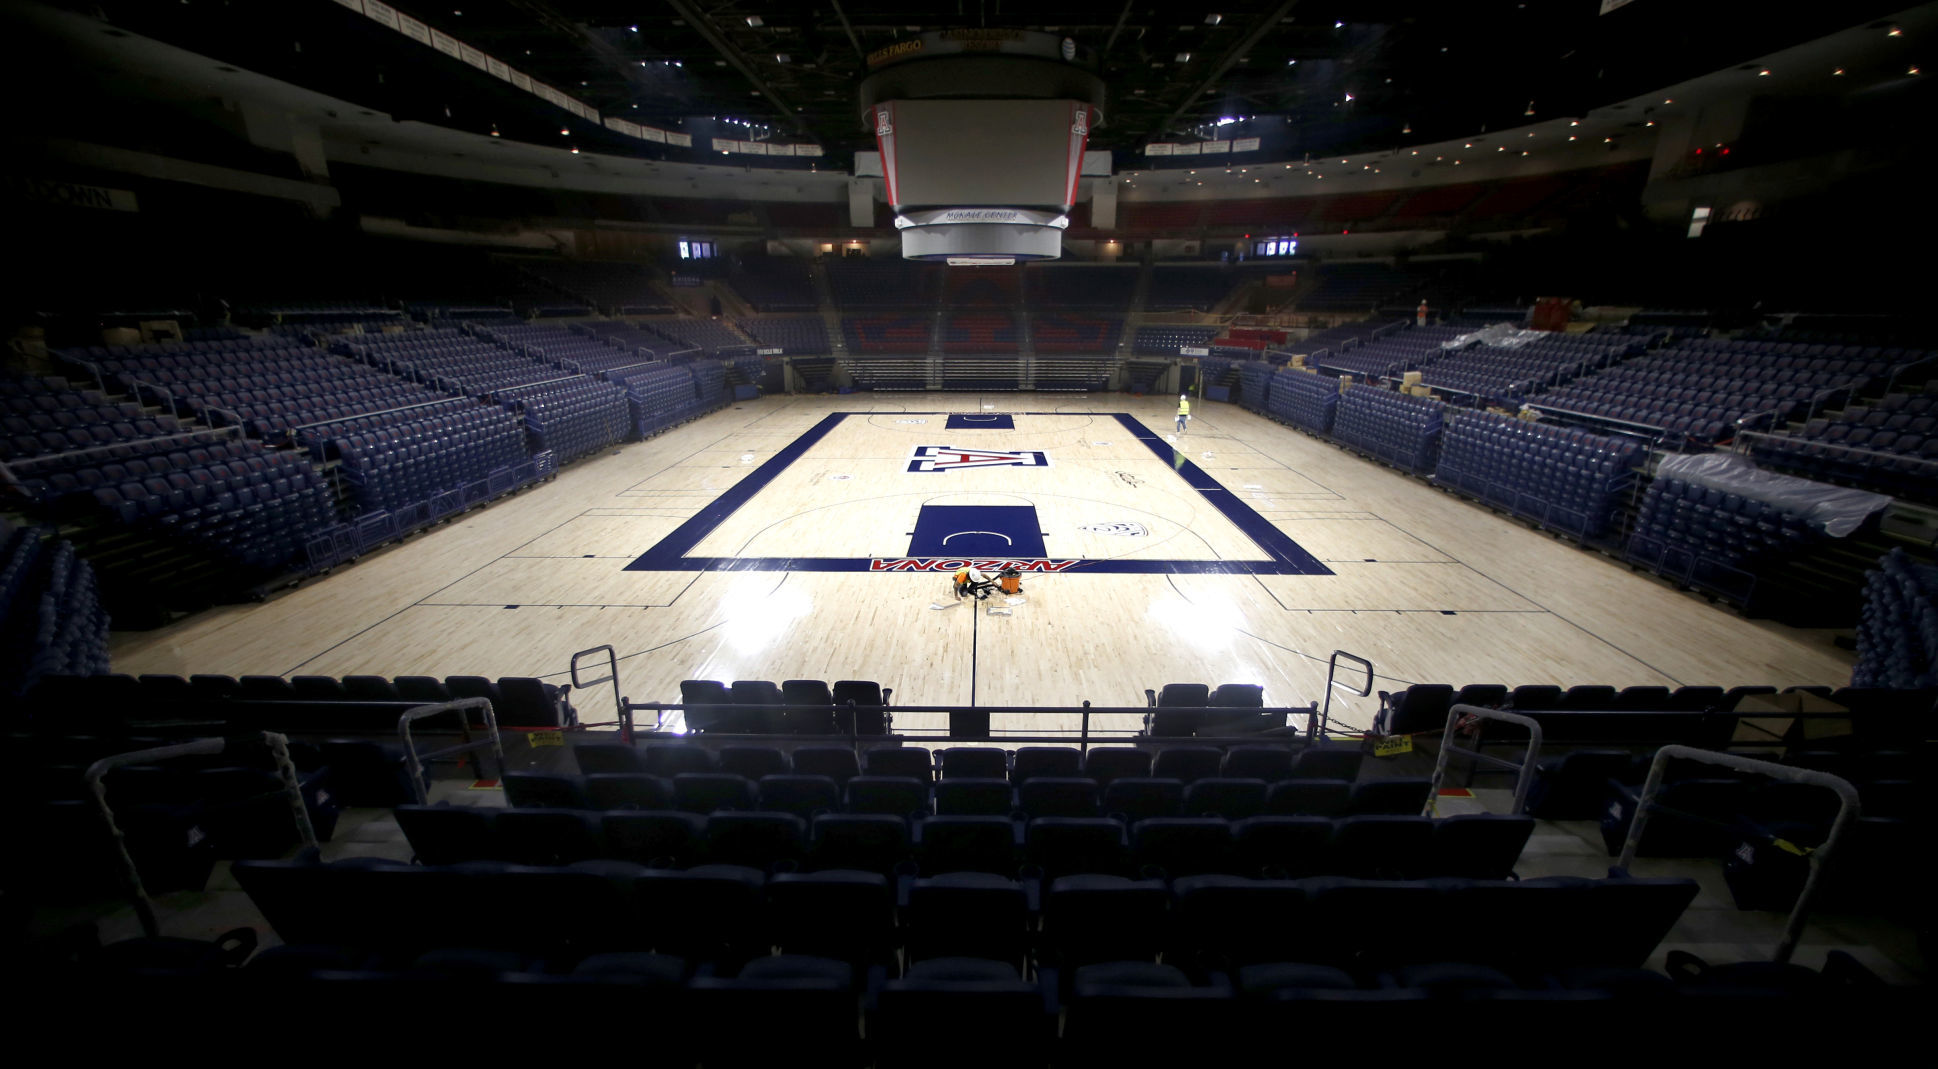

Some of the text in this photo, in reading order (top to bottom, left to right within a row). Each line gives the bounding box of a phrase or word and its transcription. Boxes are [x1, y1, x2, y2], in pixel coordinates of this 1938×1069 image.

[889, 40, 921, 56] FARGO
[877, 111, 892, 135] A
[1072, 111, 1087, 135] A
[870, 558, 1080, 572] ARIZONA
